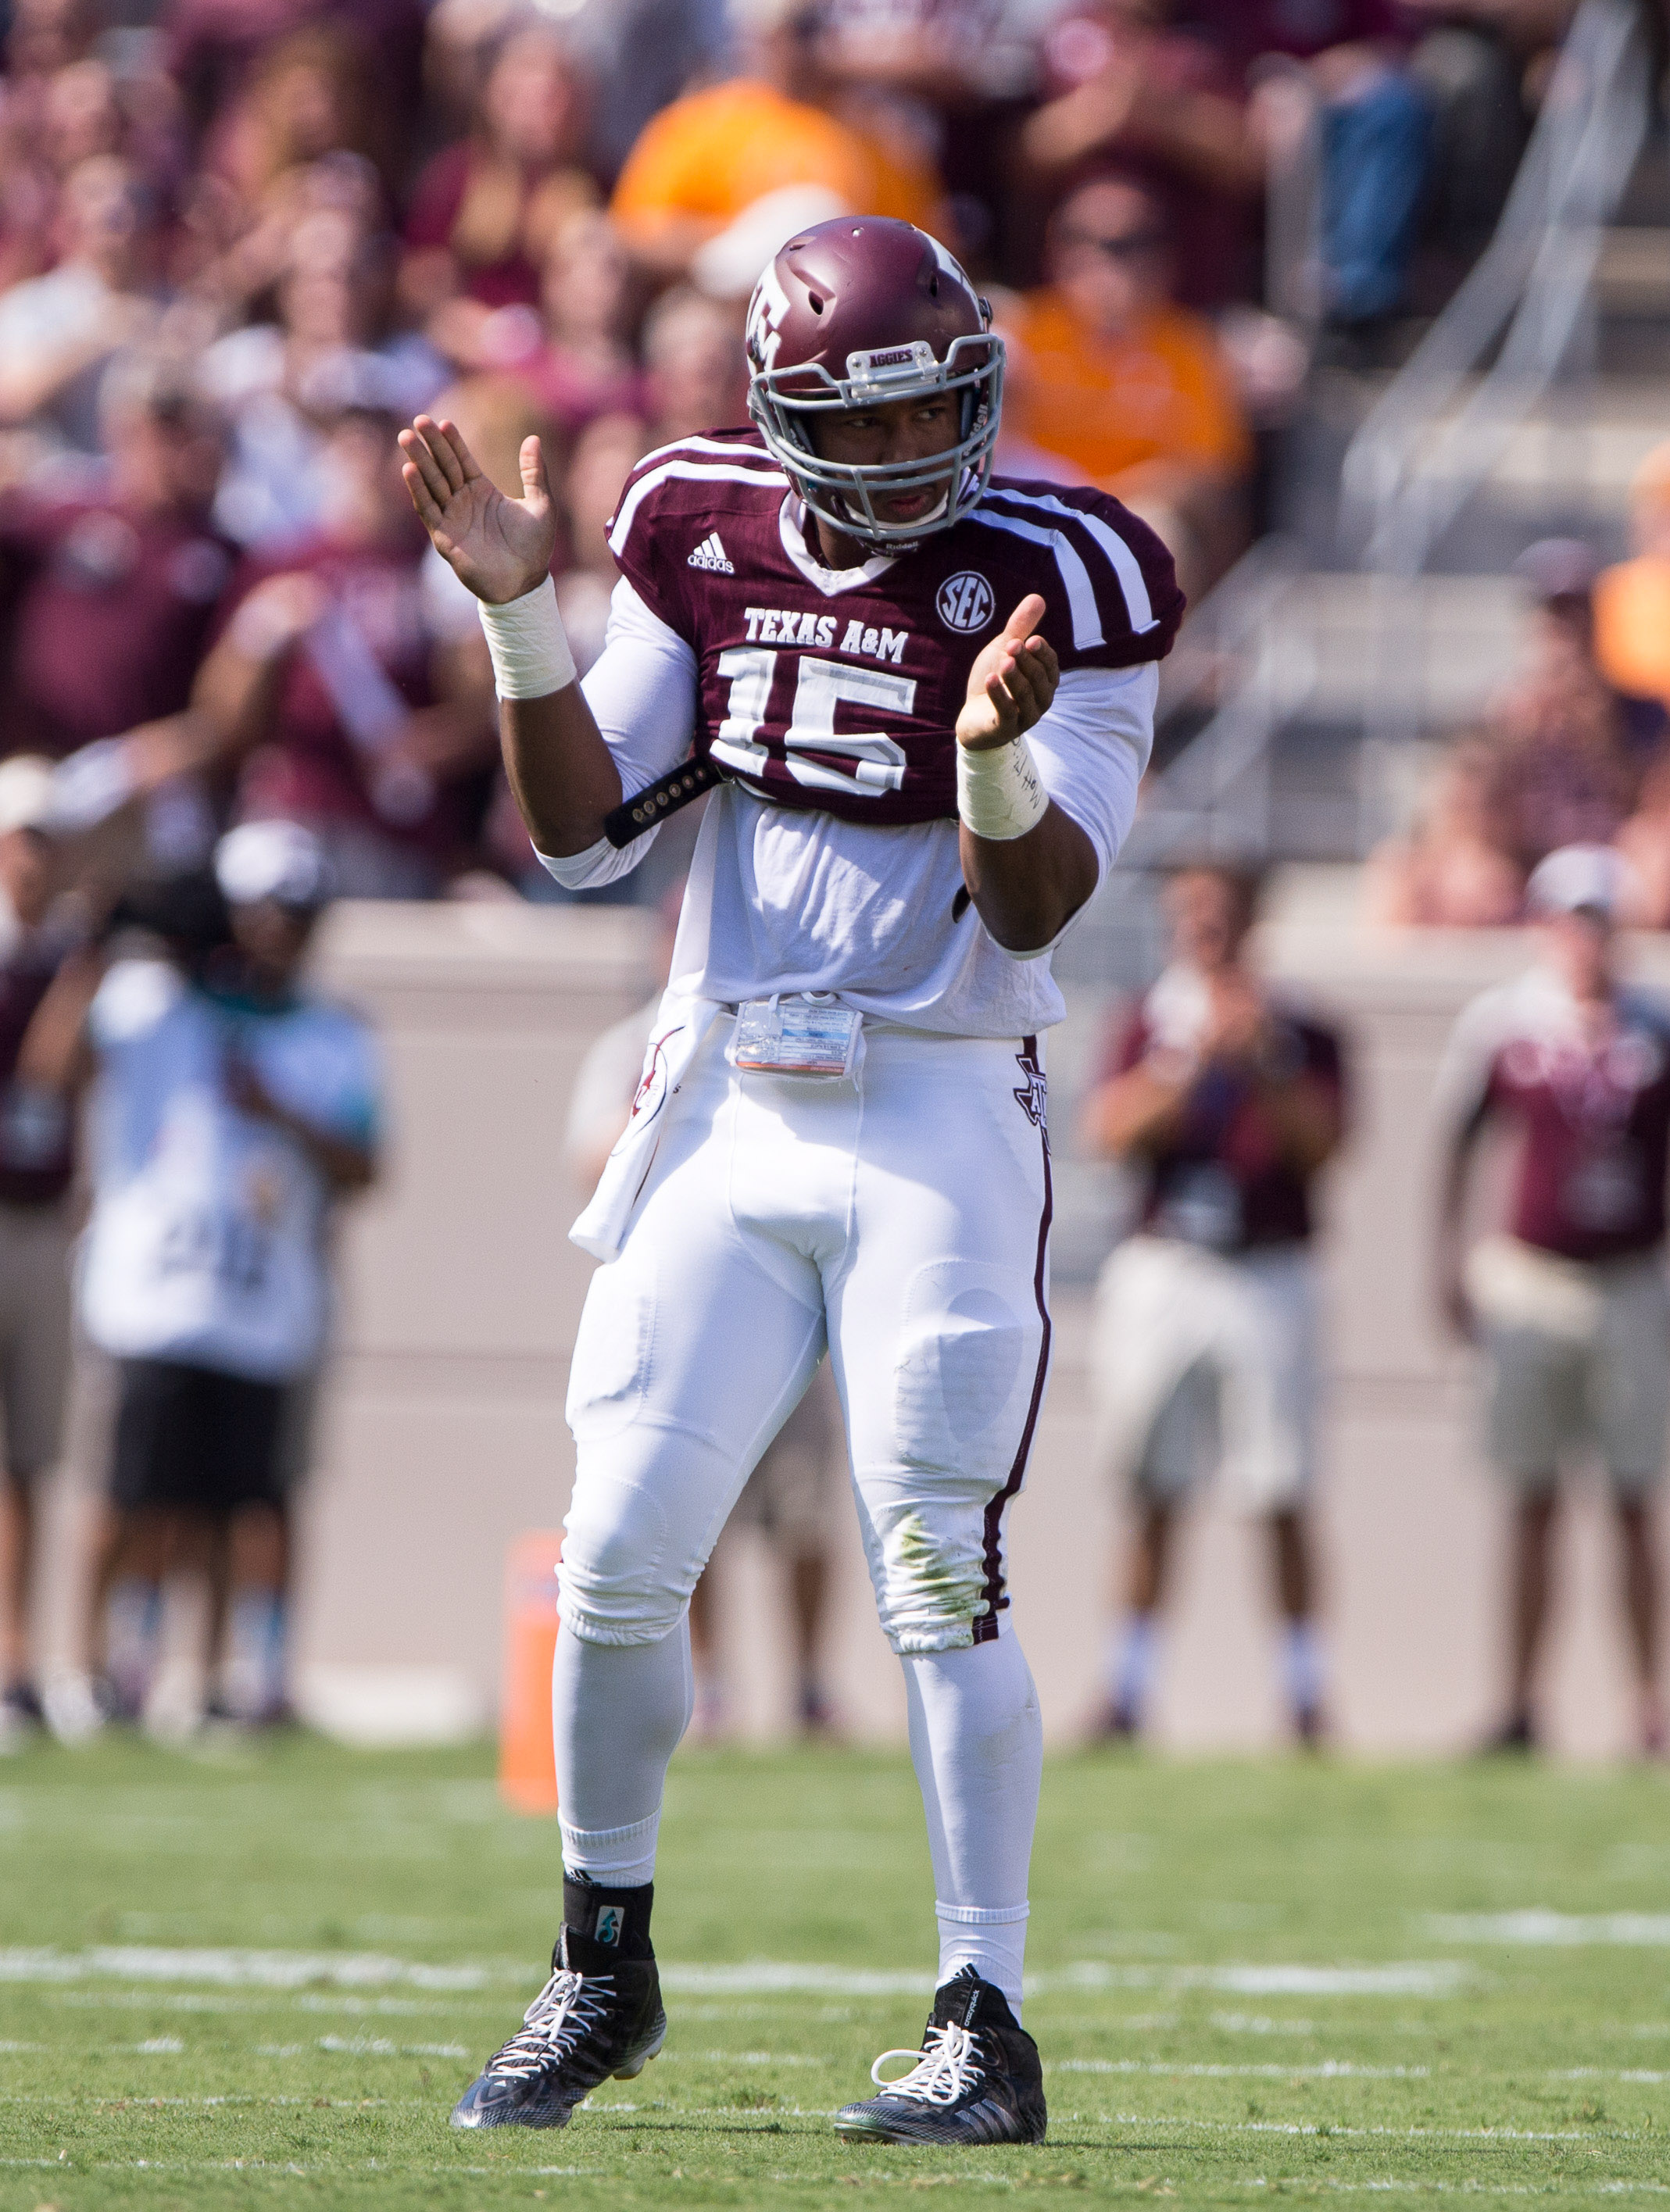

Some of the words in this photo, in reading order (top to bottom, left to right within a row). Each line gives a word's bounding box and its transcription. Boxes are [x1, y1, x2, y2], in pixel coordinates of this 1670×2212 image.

[869, 348, 914, 368] AGGIES
[688, 554, 735, 574] adidas
[942, 576, 989, 627] SEC
[744, 606, 837, 648] TEXAS
[839, 620, 909, 663] A&M
[710, 645, 917, 798] 15
[964, 1989, 980, 2027] crazyquick
